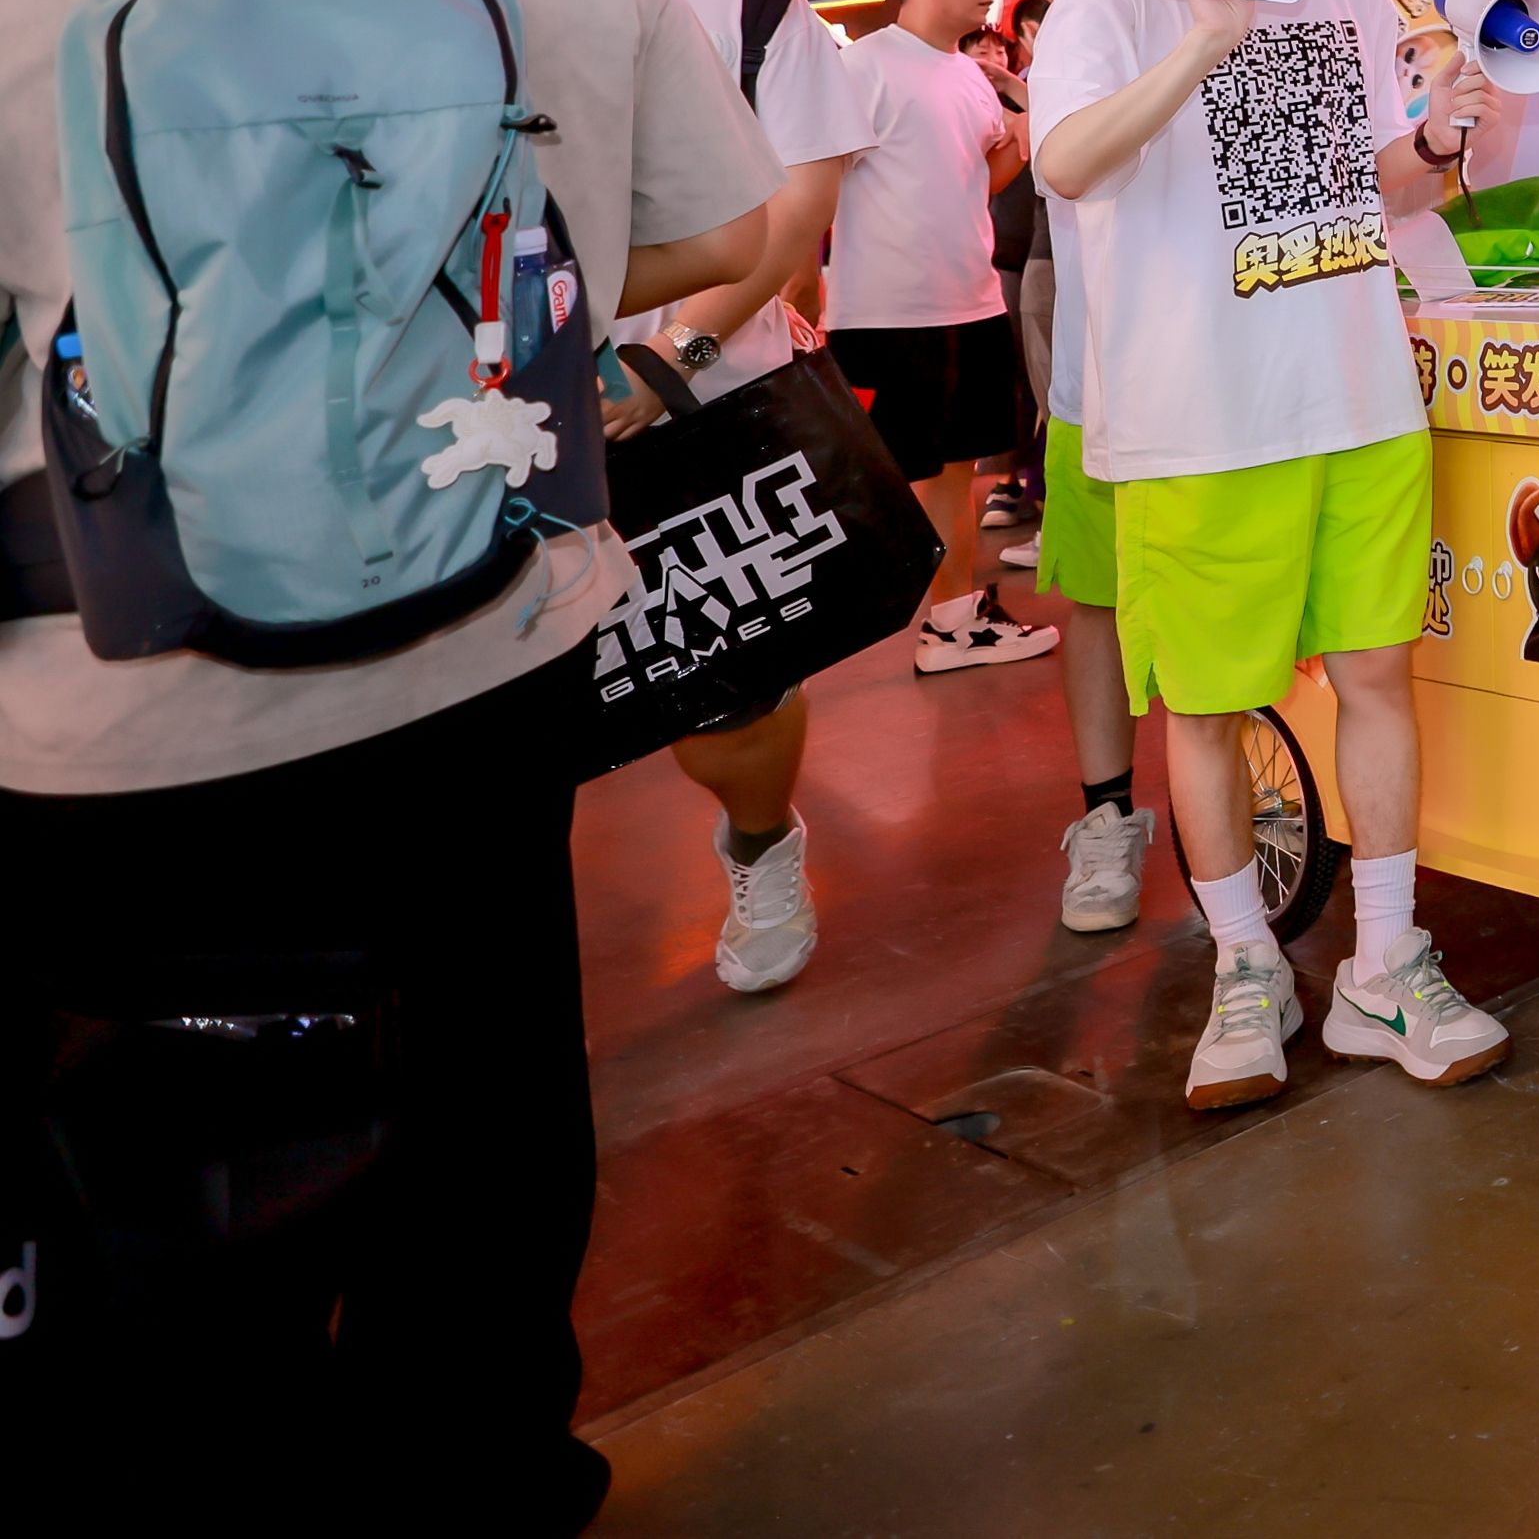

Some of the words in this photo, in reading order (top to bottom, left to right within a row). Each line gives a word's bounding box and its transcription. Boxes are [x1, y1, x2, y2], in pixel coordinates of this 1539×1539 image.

[1234, 212, 1389, 294] 奥星热浪
[600, 597, 813, 703] GAMES
